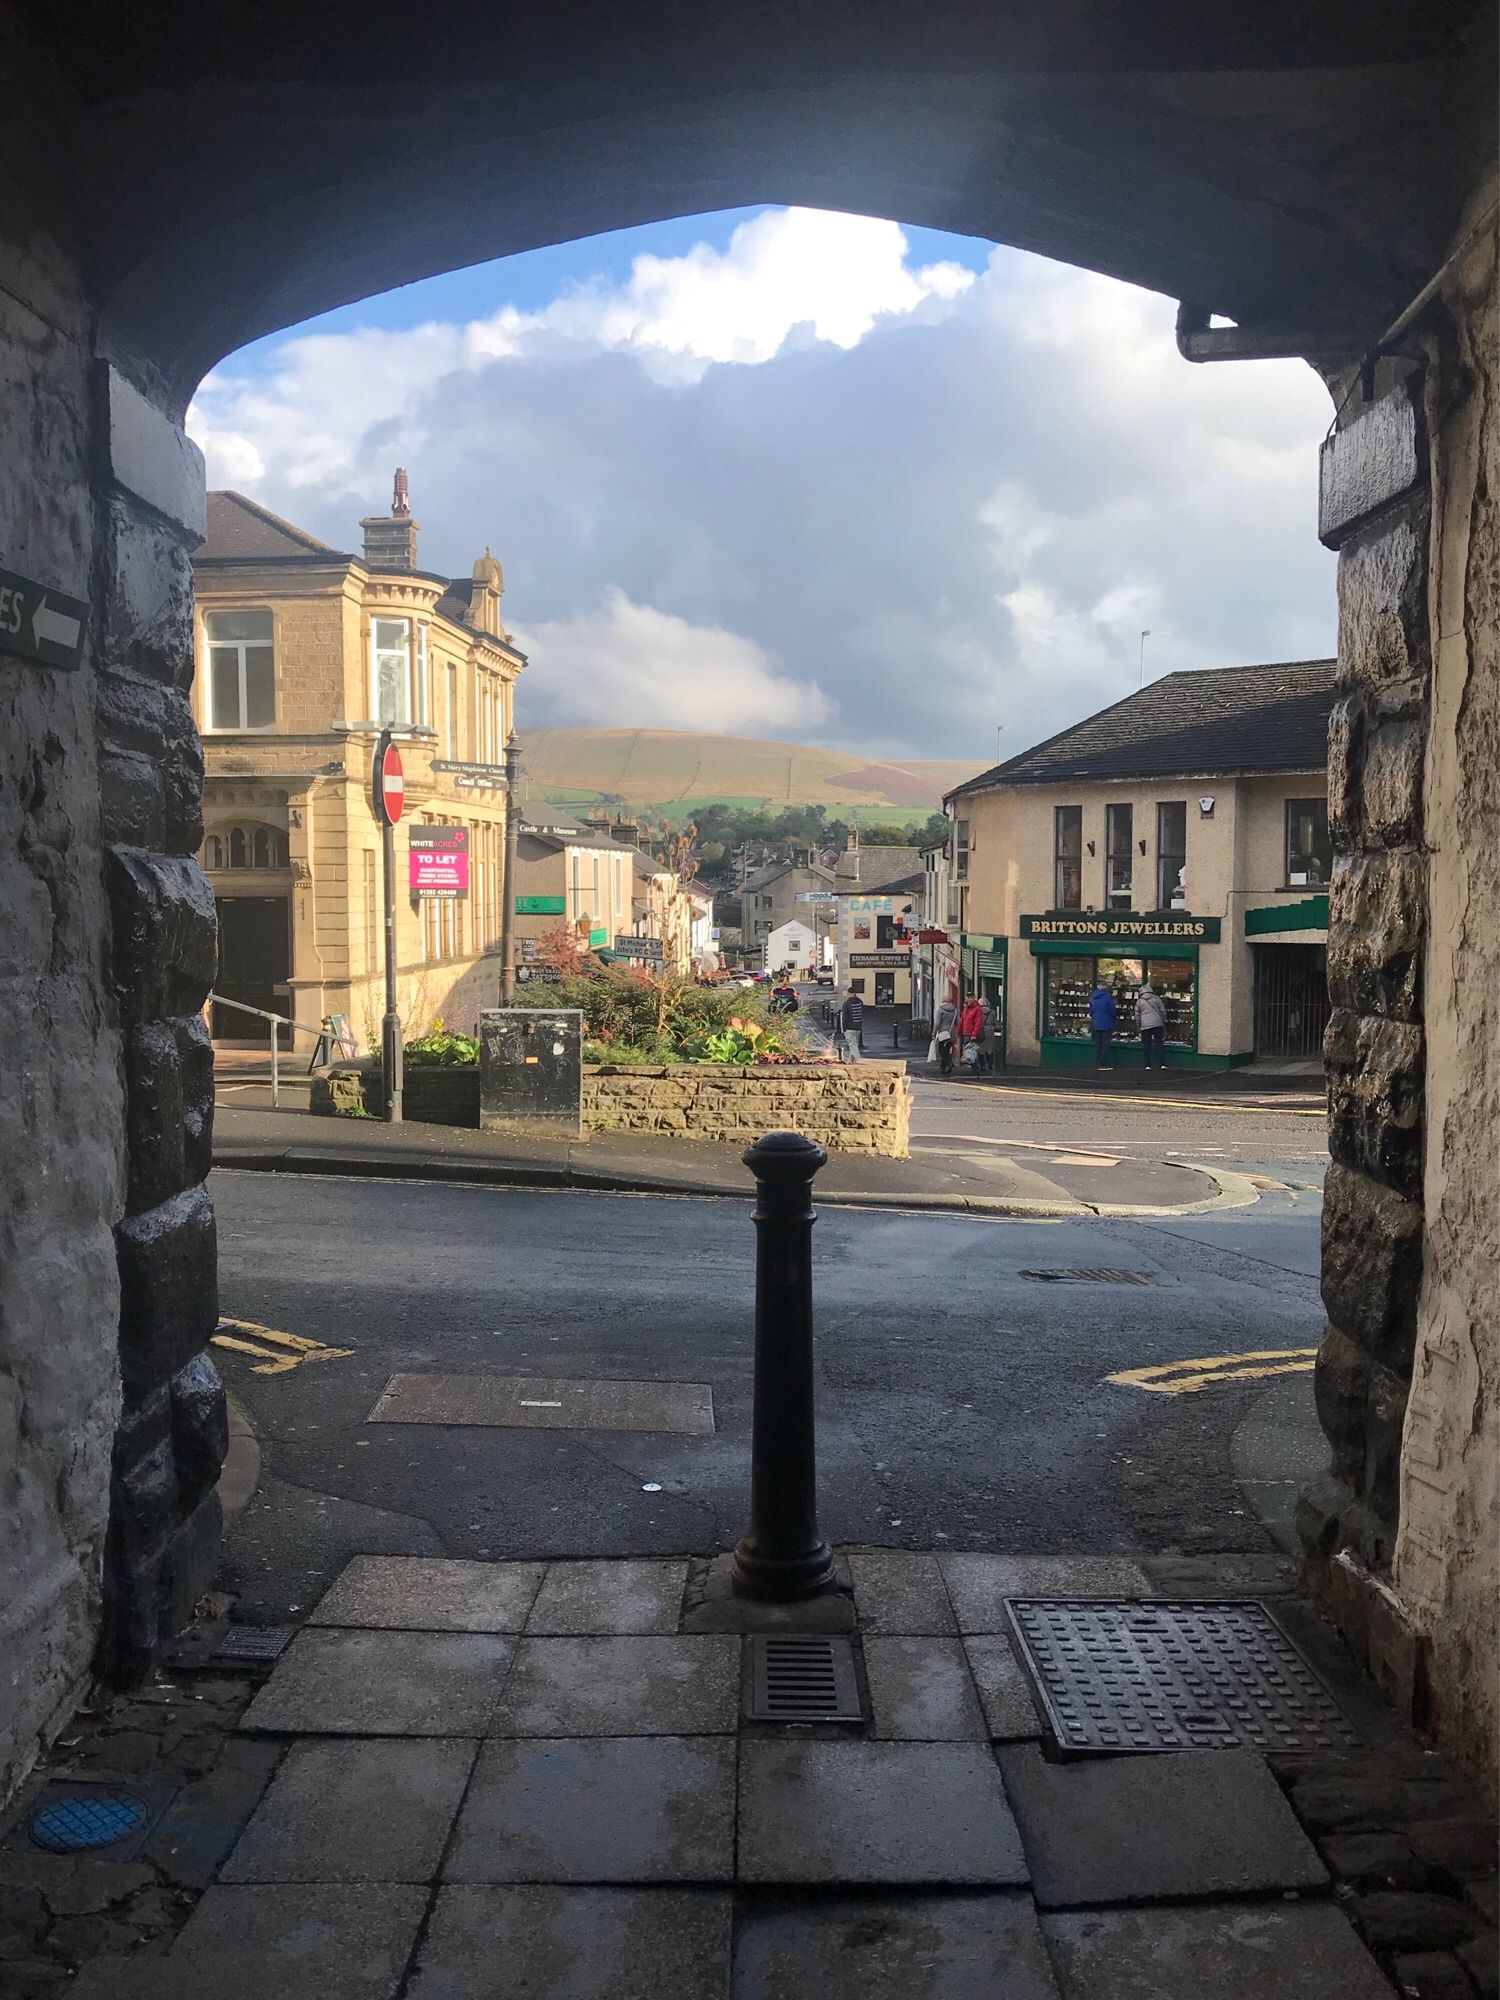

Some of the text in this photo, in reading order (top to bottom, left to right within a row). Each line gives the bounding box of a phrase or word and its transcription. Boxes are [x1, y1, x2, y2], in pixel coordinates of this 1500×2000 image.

[553, 827, 577, 835] Museum
[417, 854, 457, 864] TO LET
[1031, 921, 1205, 936] BRITTONS JEWELLERS
